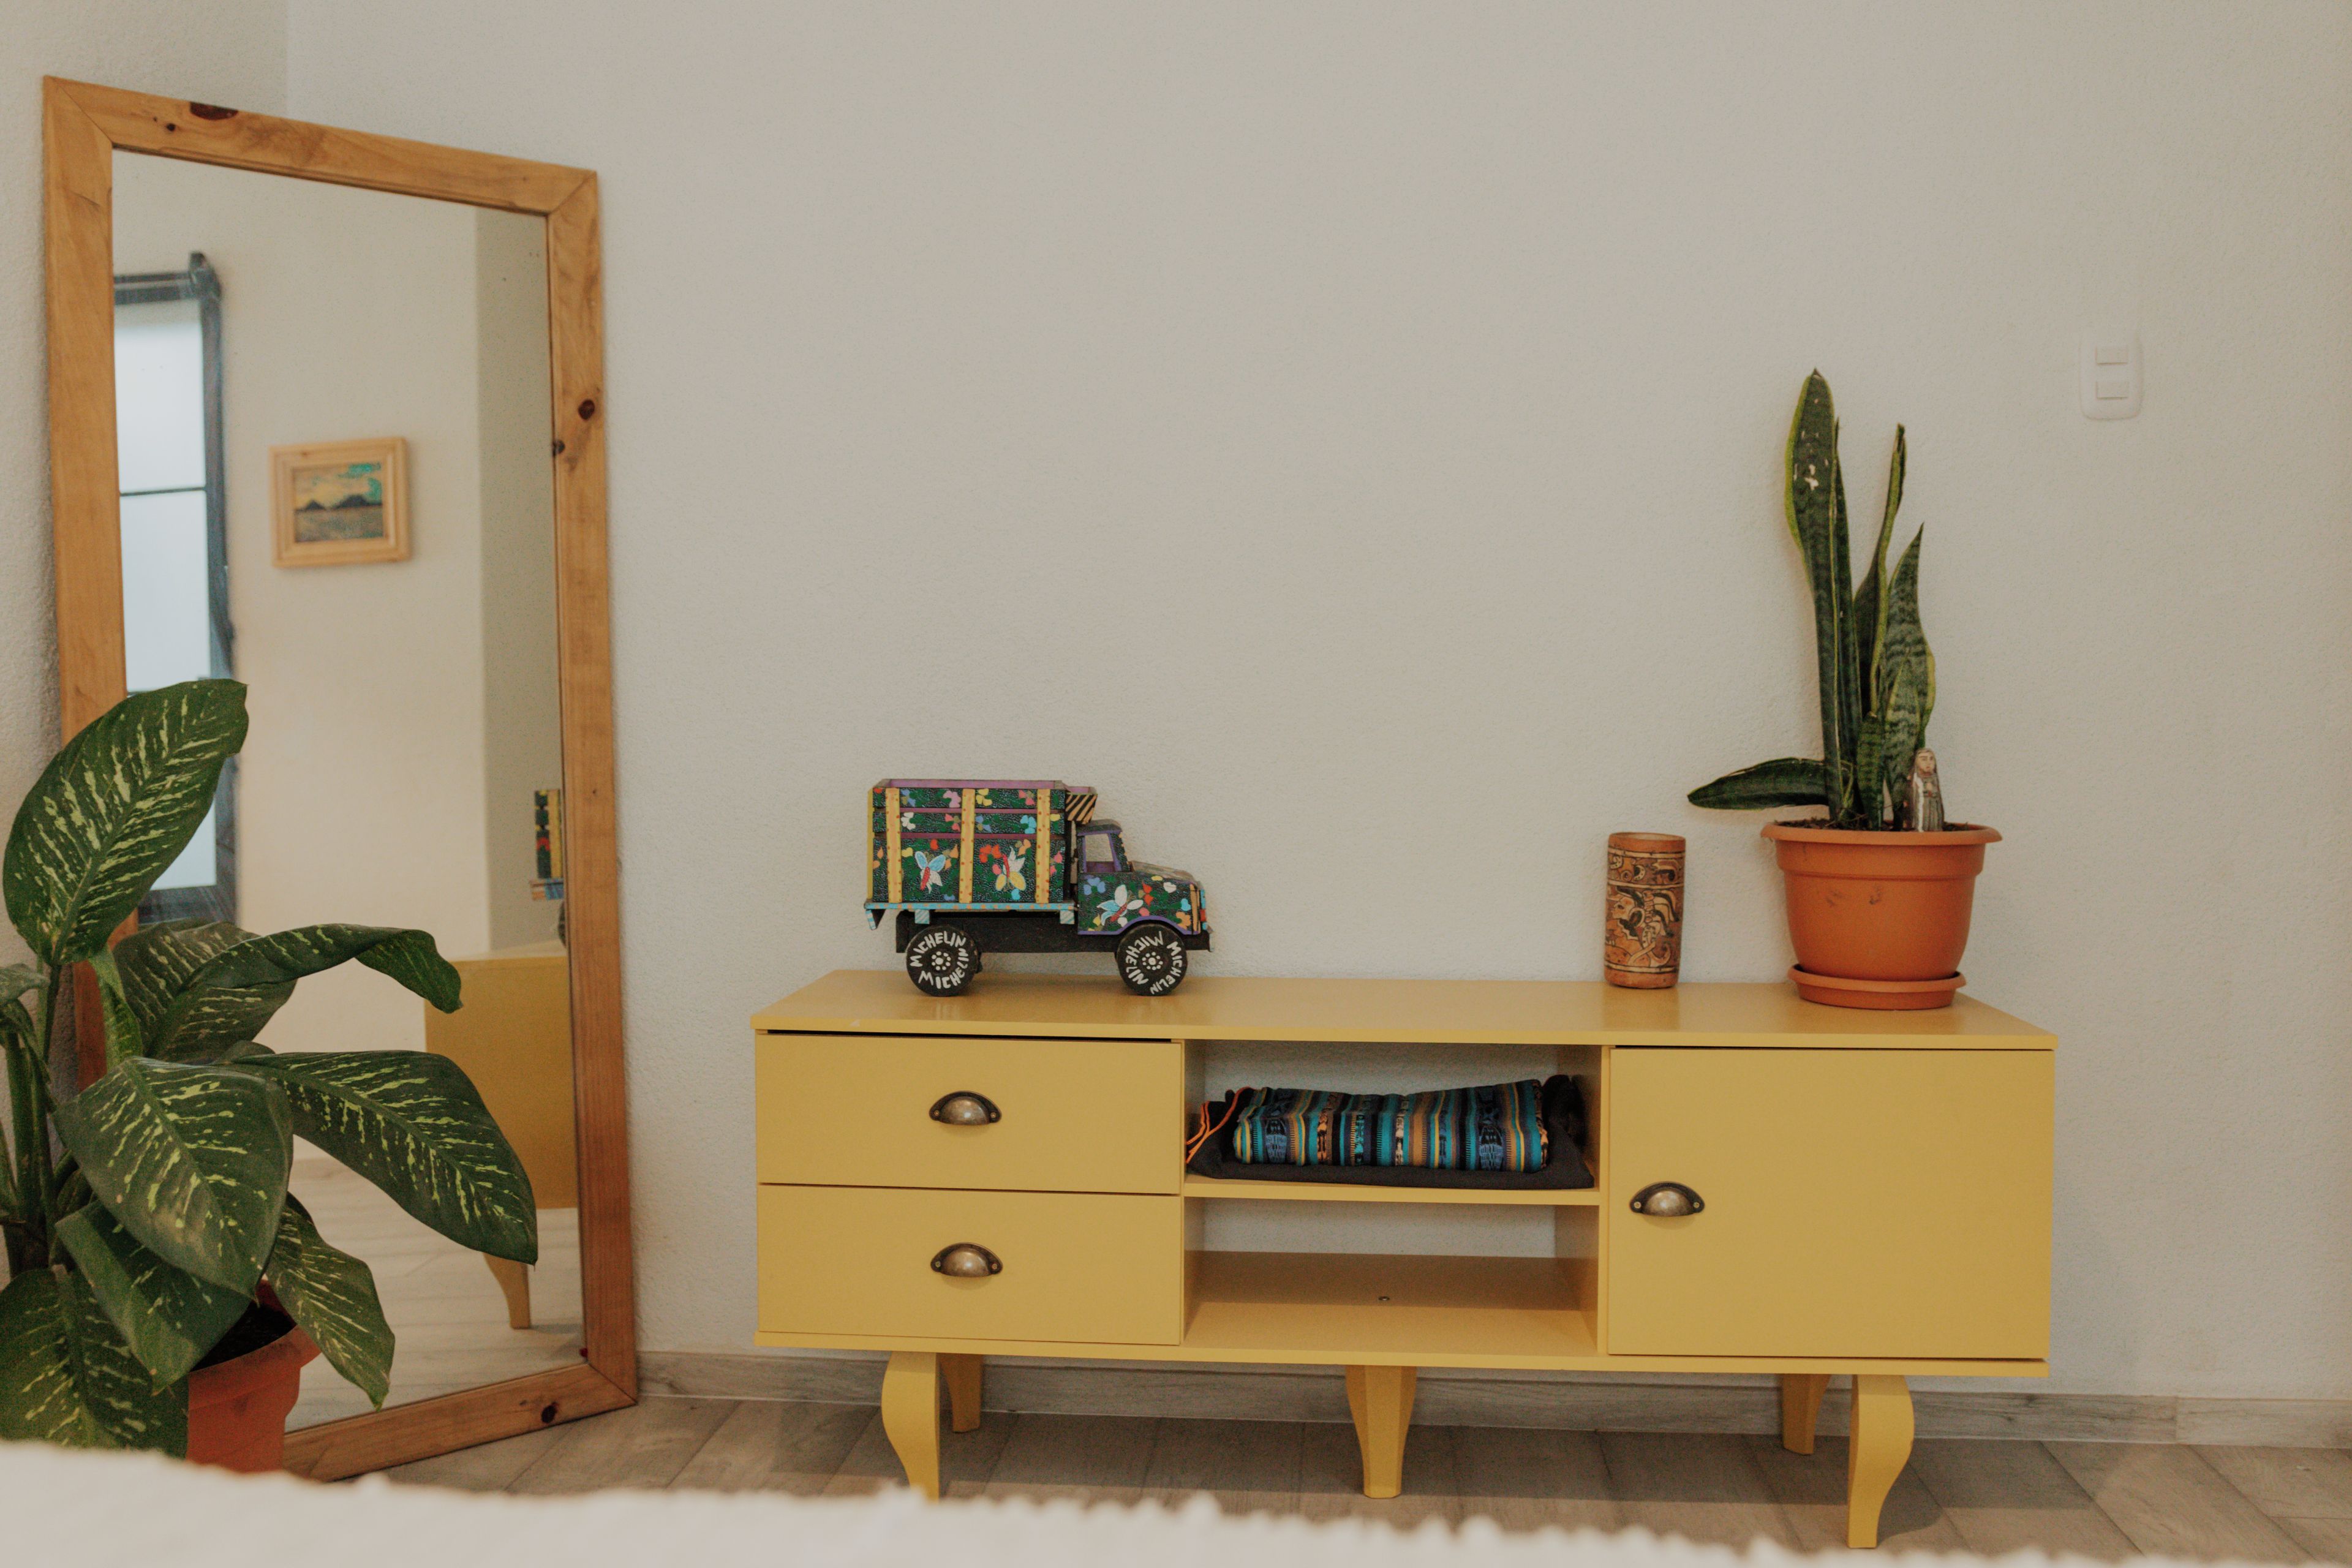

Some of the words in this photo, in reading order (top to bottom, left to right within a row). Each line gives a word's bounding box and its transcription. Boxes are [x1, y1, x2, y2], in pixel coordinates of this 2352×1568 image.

[910, 930, 967, 967] MICHELIN
[918, 948, 970, 989] MICHELIN
[1125, 930, 1164, 985] MICHELIN
[1149, 941, 1183, 995] MICHELIN
